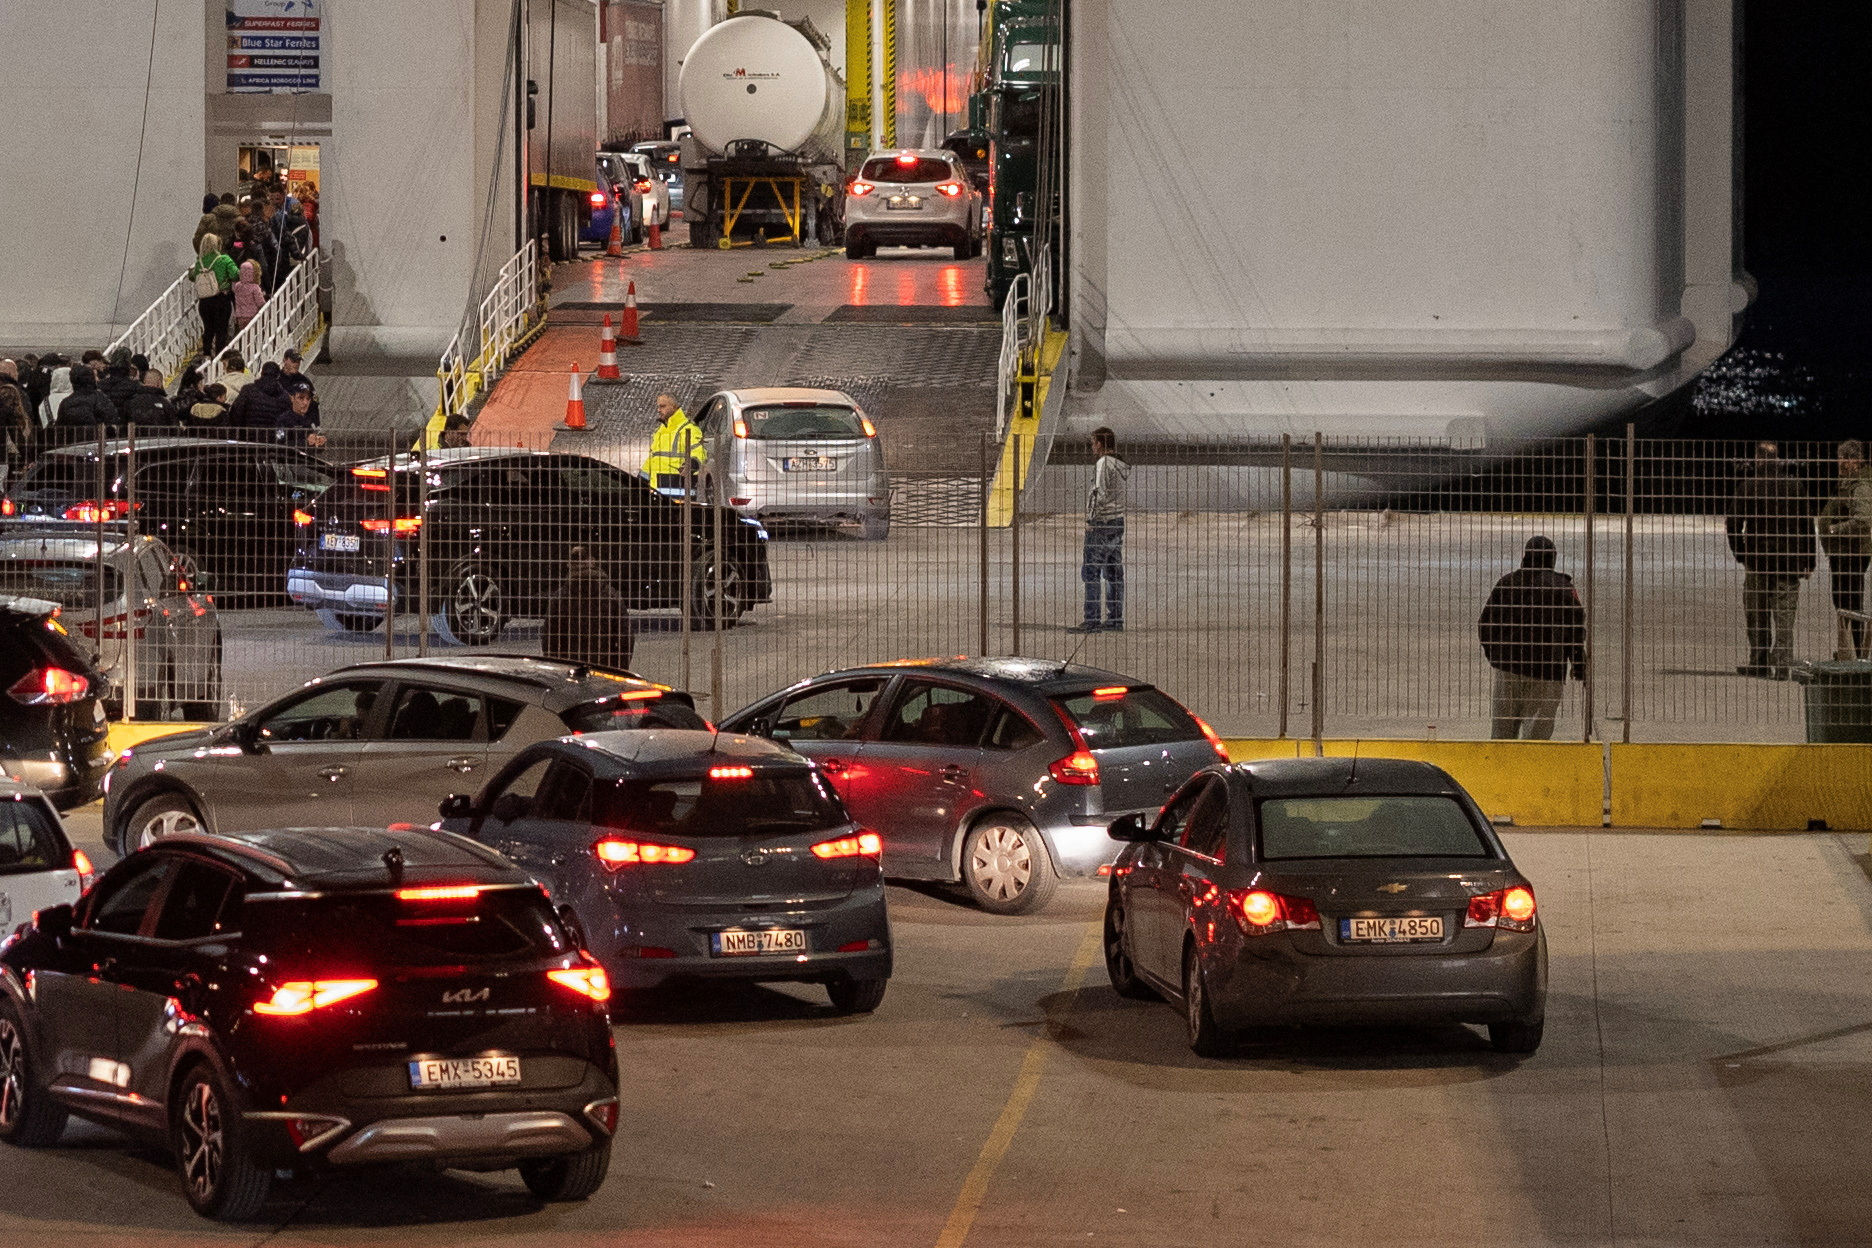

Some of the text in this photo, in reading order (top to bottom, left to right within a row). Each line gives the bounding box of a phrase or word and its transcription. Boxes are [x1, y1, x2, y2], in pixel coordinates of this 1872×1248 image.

[242, 37, 316, 48] Blue Star Ferries
